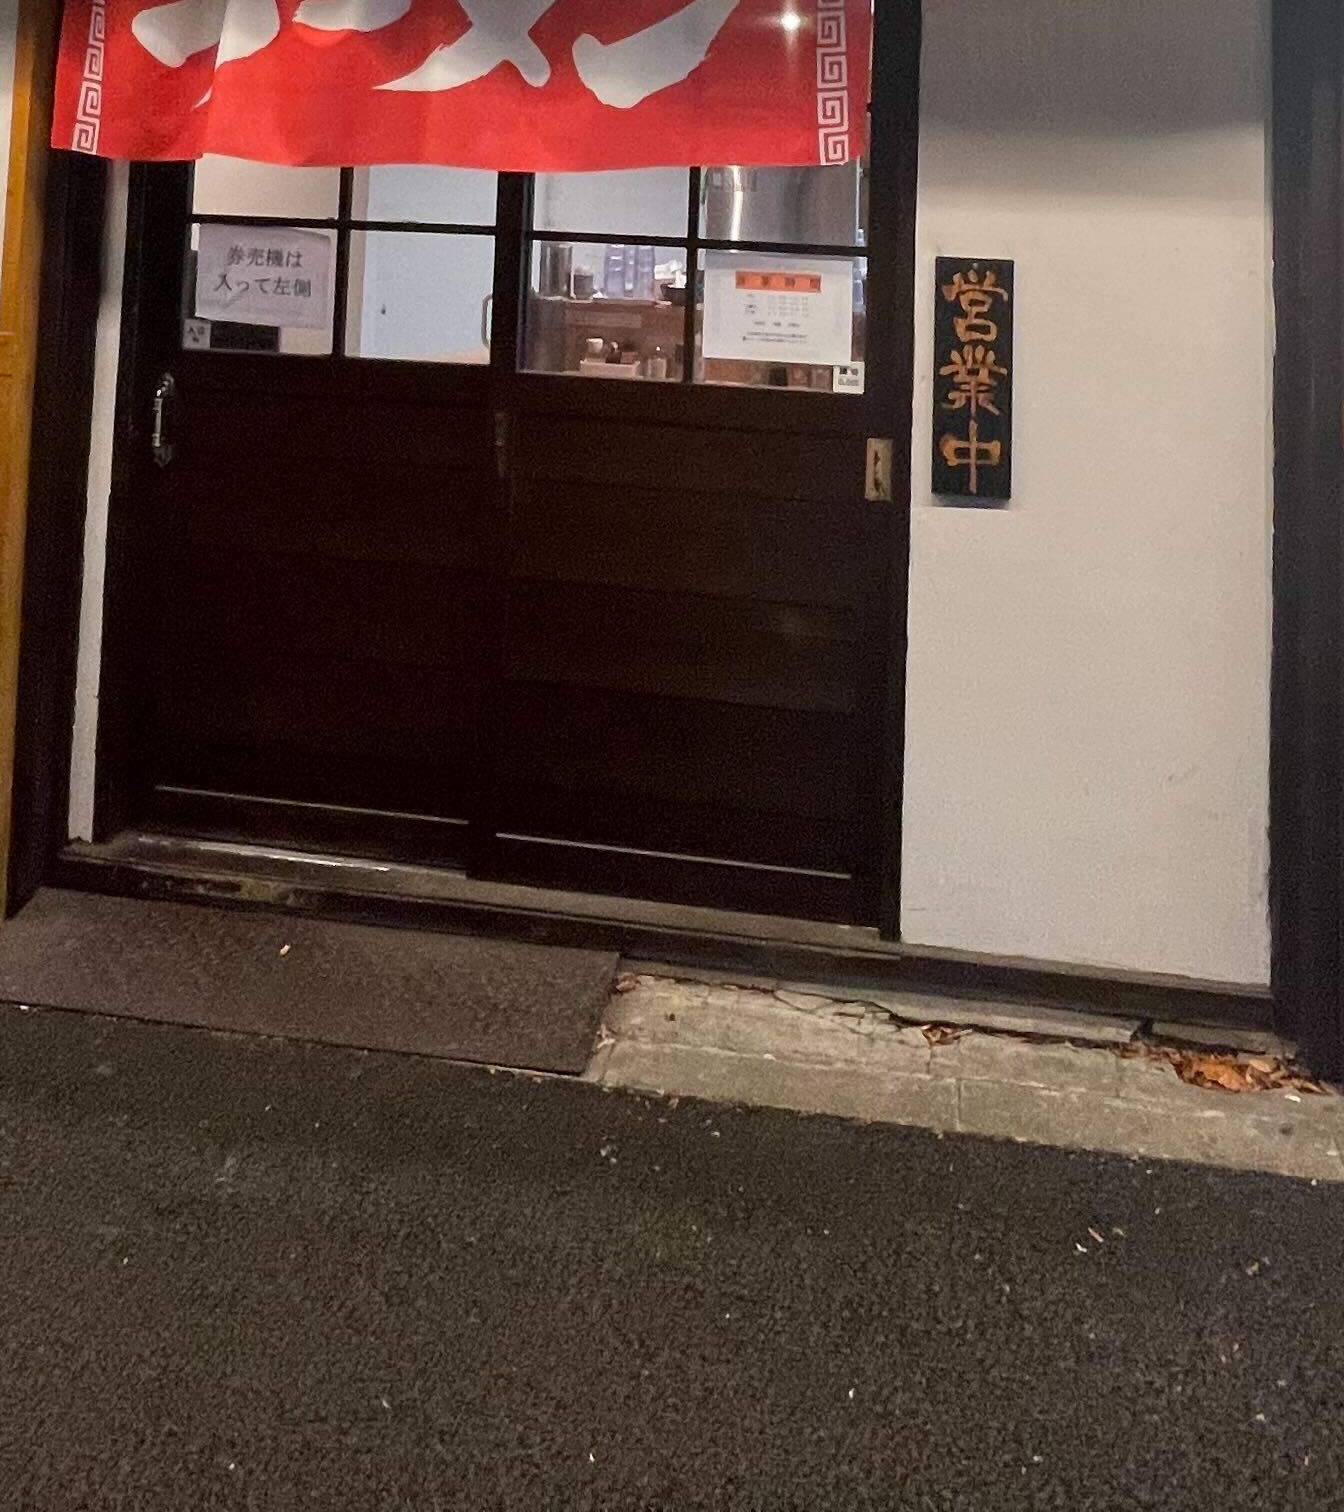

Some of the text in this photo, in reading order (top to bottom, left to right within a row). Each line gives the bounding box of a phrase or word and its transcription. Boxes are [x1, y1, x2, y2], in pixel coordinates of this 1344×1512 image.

[226, 244, 304, 268] 券売機は
[214, 272, 312, 298] 入って左側
[938, 269, 1009, 494] 営業中
